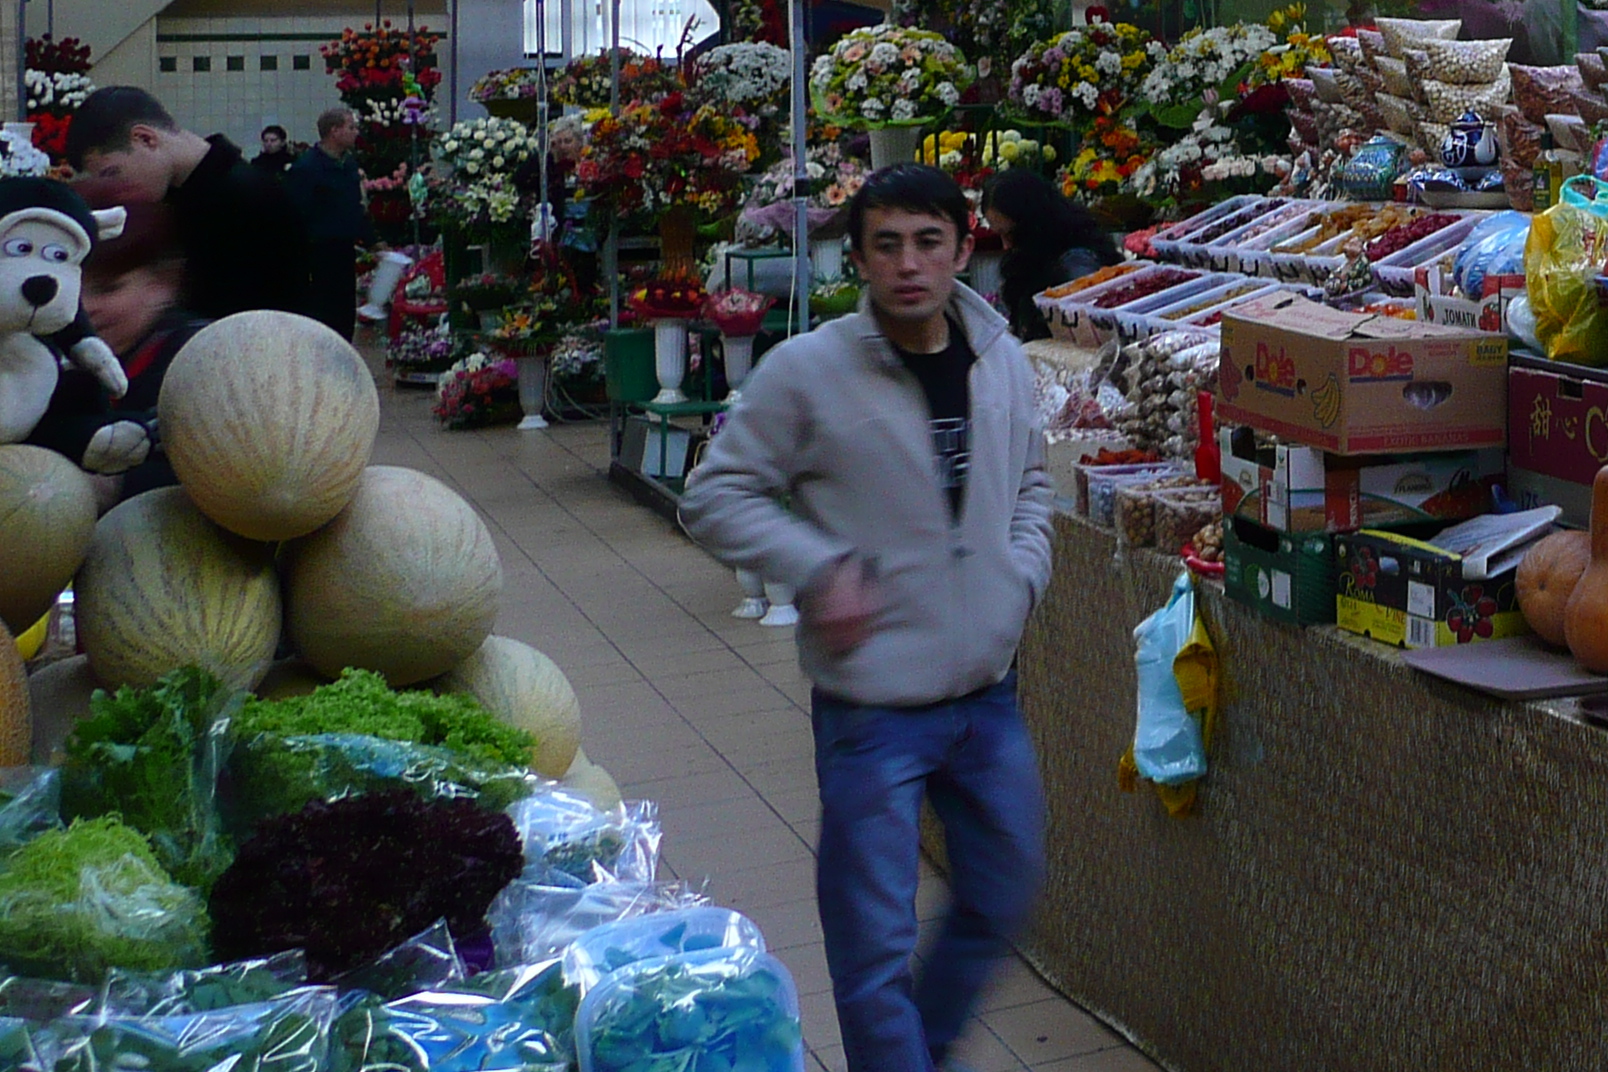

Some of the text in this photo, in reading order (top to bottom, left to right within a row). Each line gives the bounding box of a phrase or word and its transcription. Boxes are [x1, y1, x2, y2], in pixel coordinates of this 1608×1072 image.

[1256, 341, 1295, 387] Dole
[1350, 346, 1414, 377] Dole
[1338, 571, 1375, 603] ROMA
